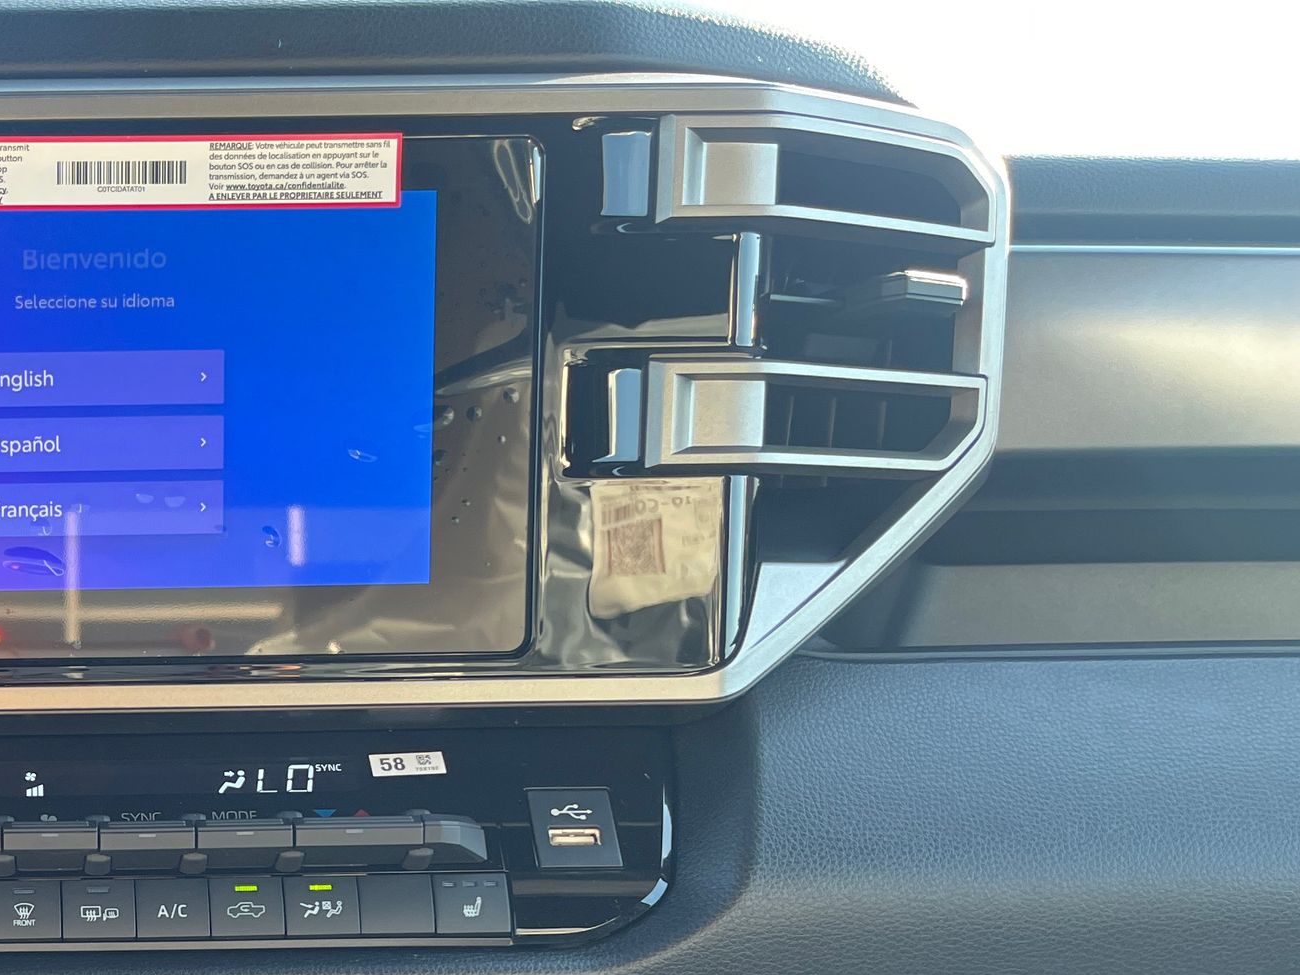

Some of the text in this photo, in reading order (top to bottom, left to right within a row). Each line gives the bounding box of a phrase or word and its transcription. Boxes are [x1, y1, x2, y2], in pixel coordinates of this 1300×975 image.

[209, 141, 254, 151] REMARQUE:
[275, 140, 305, 149] véhicule
[305, 142, 322, 150] peut
[323, 139, 365, 149] transmettre
[208, 152, 222, 160] des
[223, 152, 256, 160] données
[257, 151, 267, 160] de
[268, 151, 310, 160] localisation
[322, 151, 358, 161] appuyant
[372, 150, 379, 158] le
[208, 162, 236, 170] bouton
[237, 162, 253, 170] SOS
[290, 161, 300, 169] de
[301, 161, 334, 169] collision.
[335, 161, 353, 169] Pour
[354, 161, 379, 169] arrêter
[380, 160, 387, 168] la
[208, 172, 257, 180] transmission,
[258, 171, 298, 180] demandez
[299, 171, 304, 179] à
[316, 172, 338, 181] agent
[339, 171, 350, 179] via
[351, 170, 369, 179] SOS.
[225, 181, 346, 191] www.toyota.ca/confidentialite.
[209, 190, 383, 201] A ENLEVER PAR LE PROPRIETAIRE SEULEMENT
[23, 249, 167, 271] Bienvenido
[15, 293, 176, 310] Seleccione su idioma
[315, 763, 342, 773] SYNC
[379, 757, 406, 772] 58
[256, 765, 315, 793] LO
[120, 812, 162, 822] SYNC
[211, 810, 258, 821] MODE
[157, 903, 188, 920] A/C
[13, 919, 36, 927] FRONT
